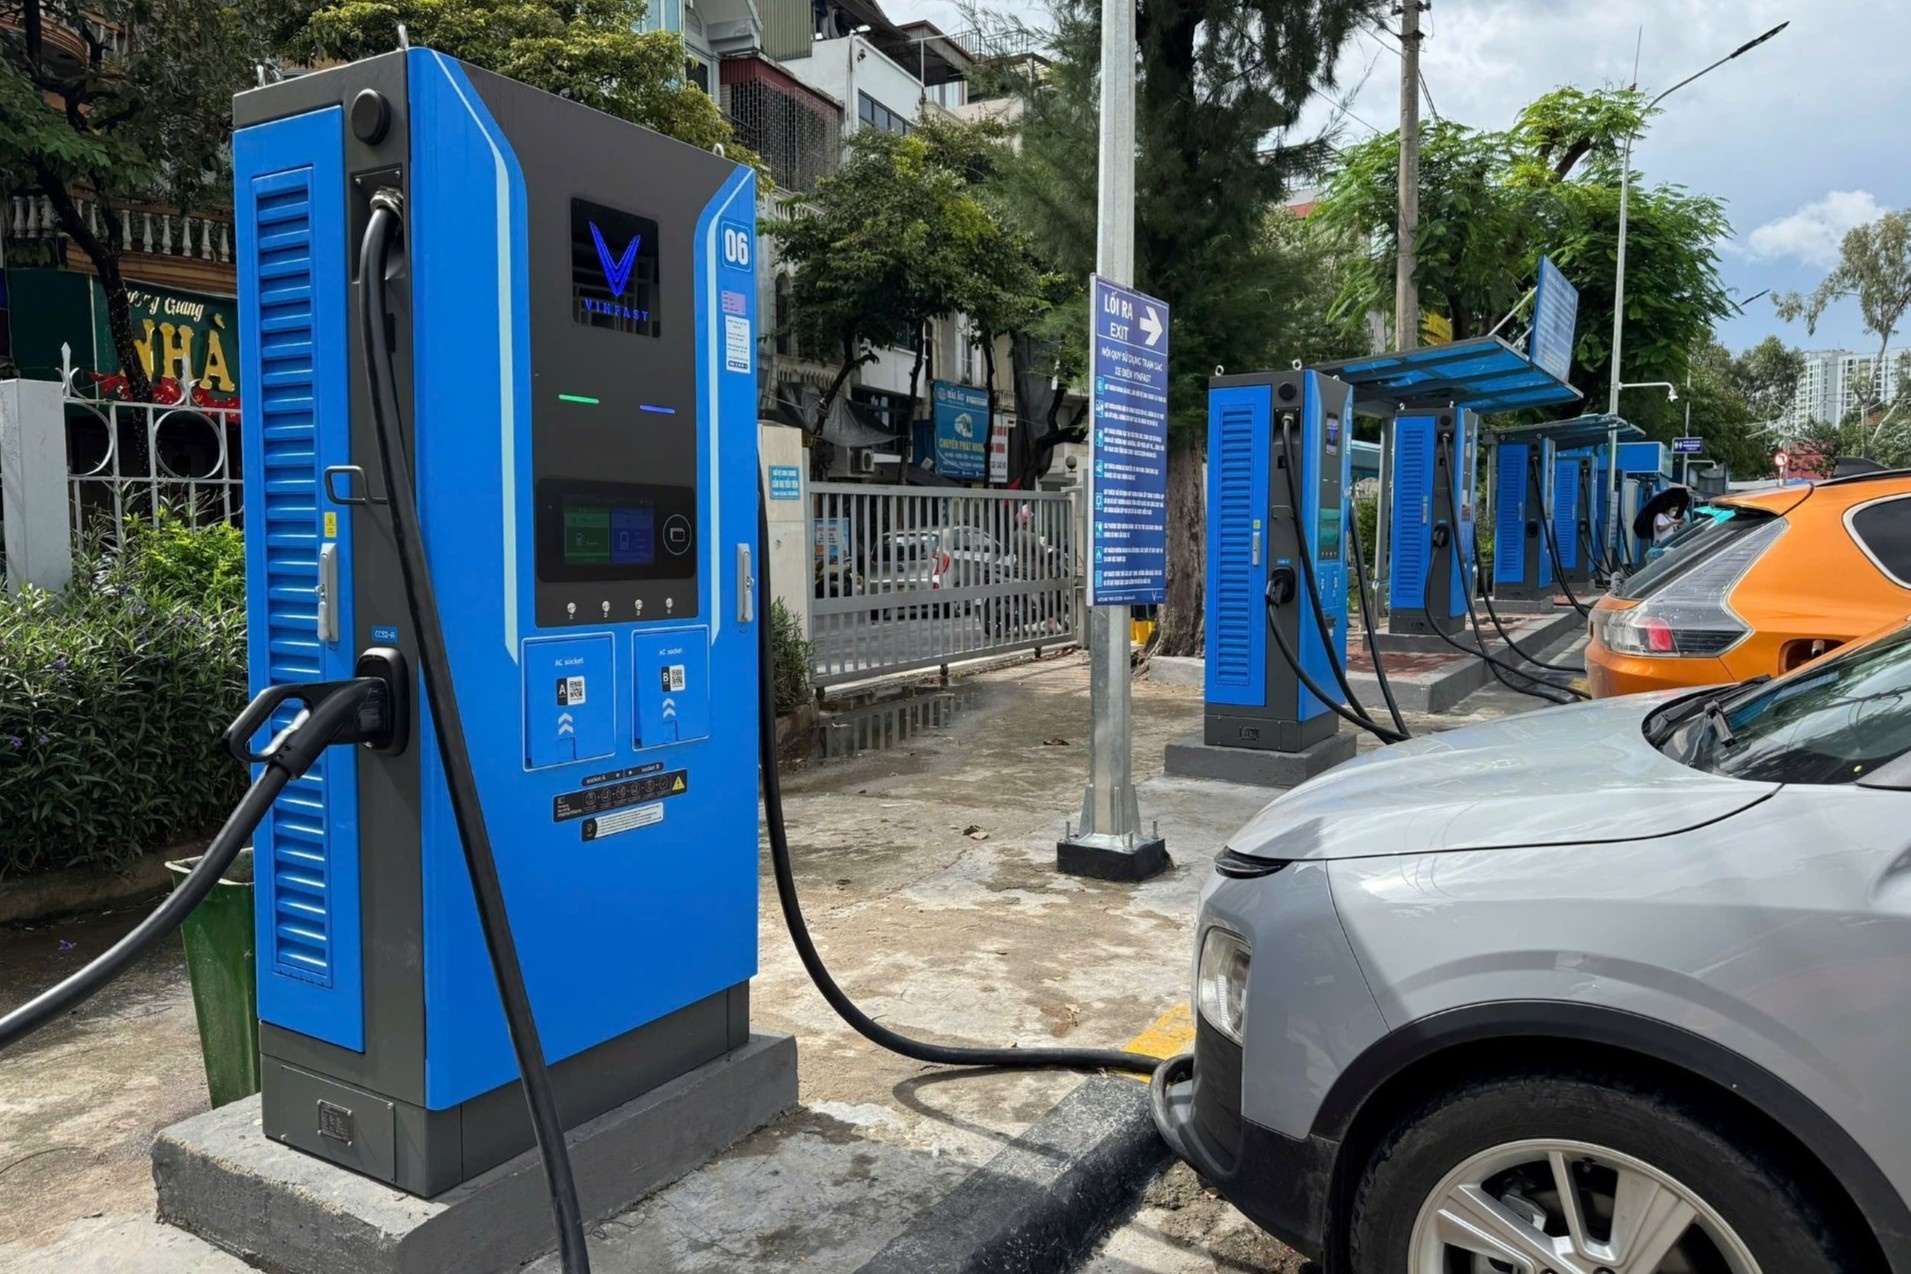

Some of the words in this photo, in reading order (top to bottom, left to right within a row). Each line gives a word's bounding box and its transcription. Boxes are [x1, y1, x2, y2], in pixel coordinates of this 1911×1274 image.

[725, 228, 749, 266] 06
[164, 297, 205, 322] Giang
[584, 298, 649, 321] VINFAST
[1104, 291, 1119, 316] LỐI
[1121, 300, 1133, 320] RA
[1110, 322, 1129, 341] EXIT
[667, 647, 683, 655] socket
[555, 659, 563, 667] AC
[564, 657, 584, 666] socket
[662, 671, 669, 682] B
[559, 683, 566, 695] A
